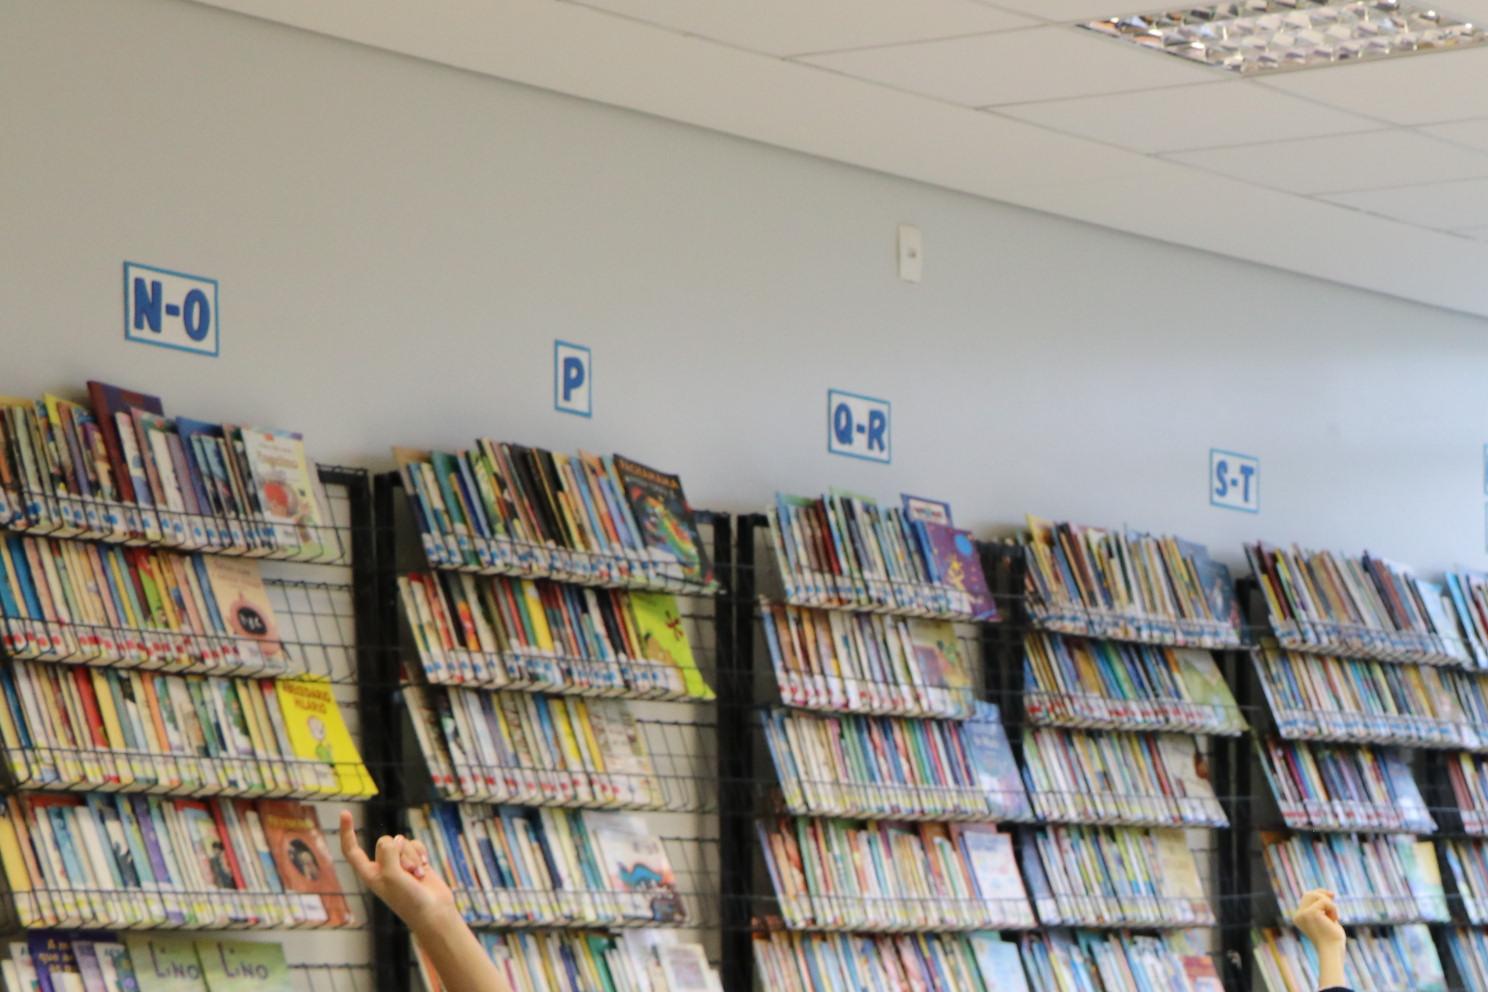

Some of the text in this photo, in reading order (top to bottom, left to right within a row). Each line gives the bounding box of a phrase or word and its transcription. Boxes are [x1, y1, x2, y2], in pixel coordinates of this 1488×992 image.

[134, 277, 210, 342] N-O
[563, 356, 585, 402] P
[834, 402, 885, 451] Q-R
[1216, 460, 1254, 502] S-T
